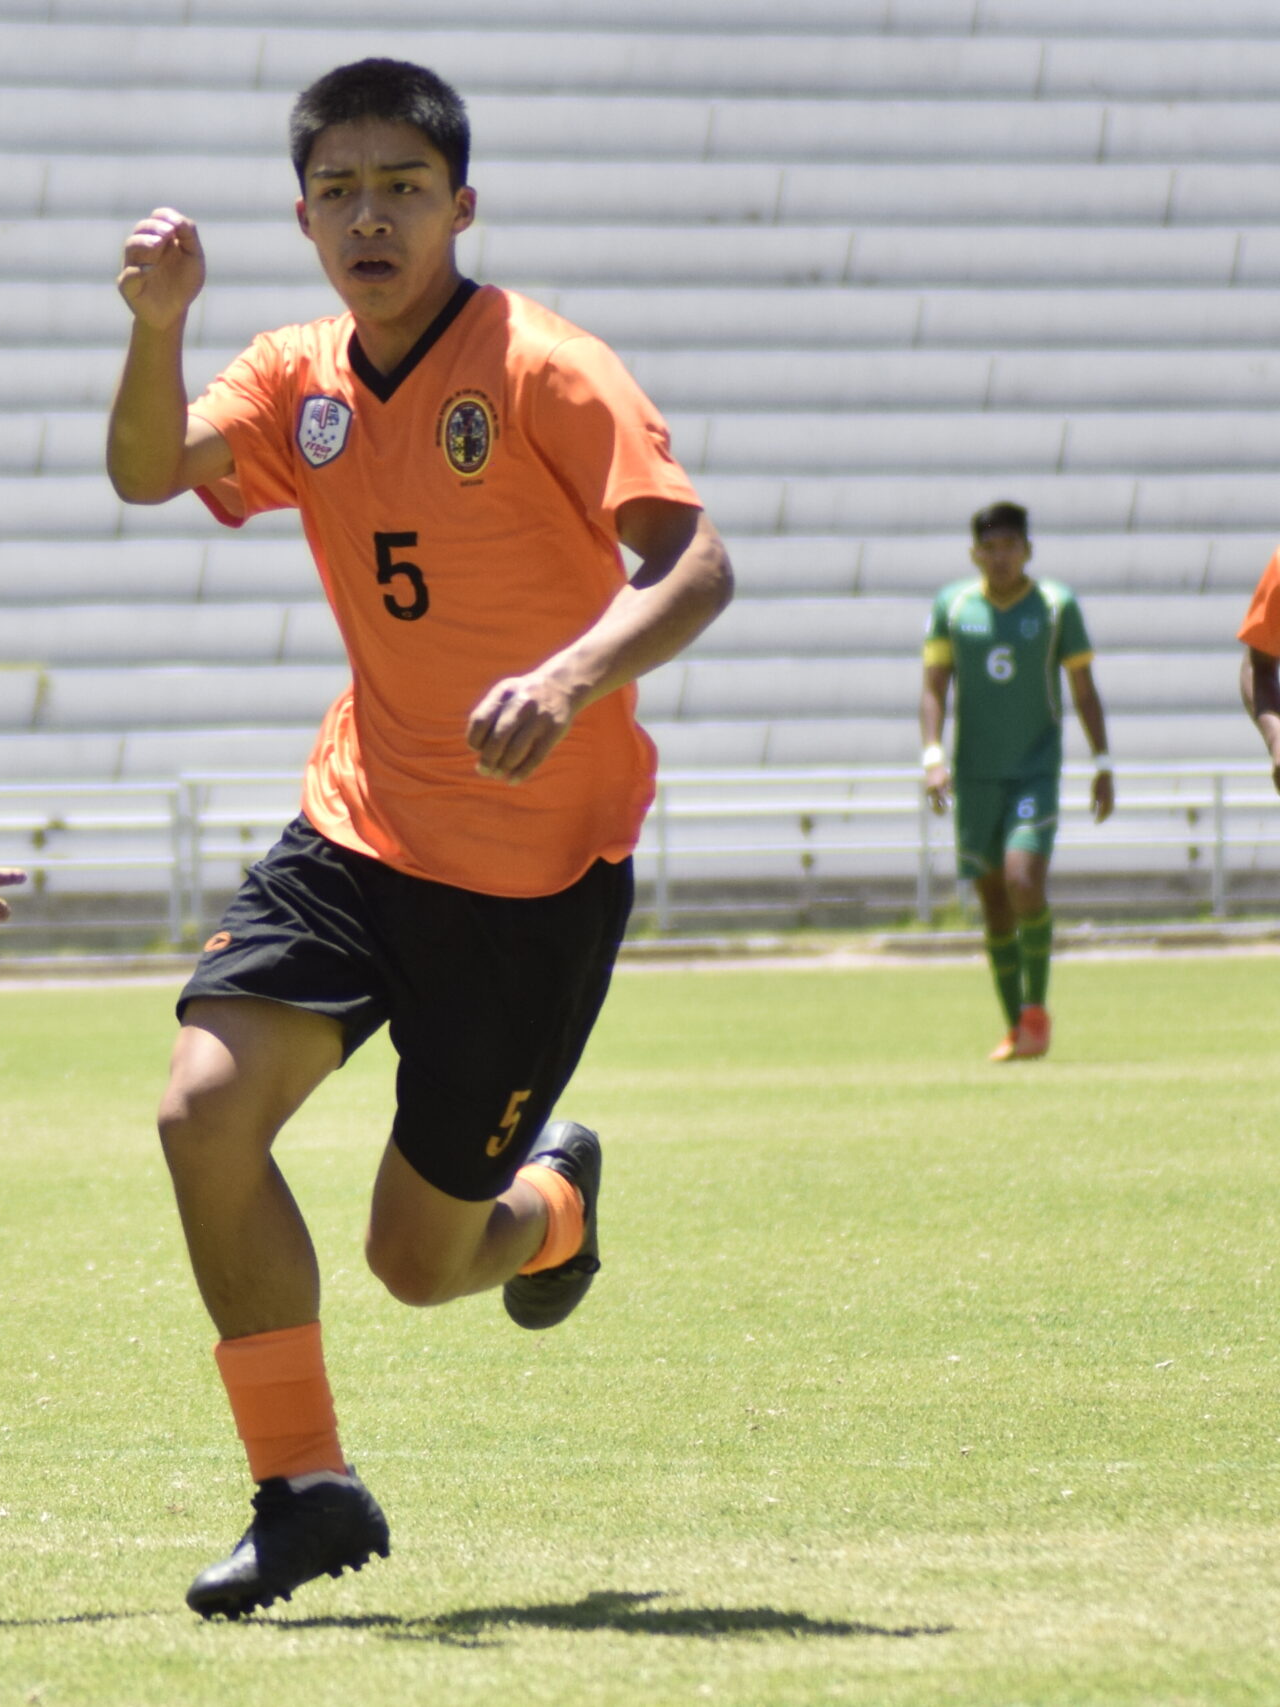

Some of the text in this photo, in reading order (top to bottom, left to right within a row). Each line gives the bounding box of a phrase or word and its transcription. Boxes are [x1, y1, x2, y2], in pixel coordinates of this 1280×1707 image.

[374, 531, 430, 621] 5
[986, 646, 1013, 681] 6
[1017, 796, 1035, 819] 6
[486, 1088, 532, 1157] 5
